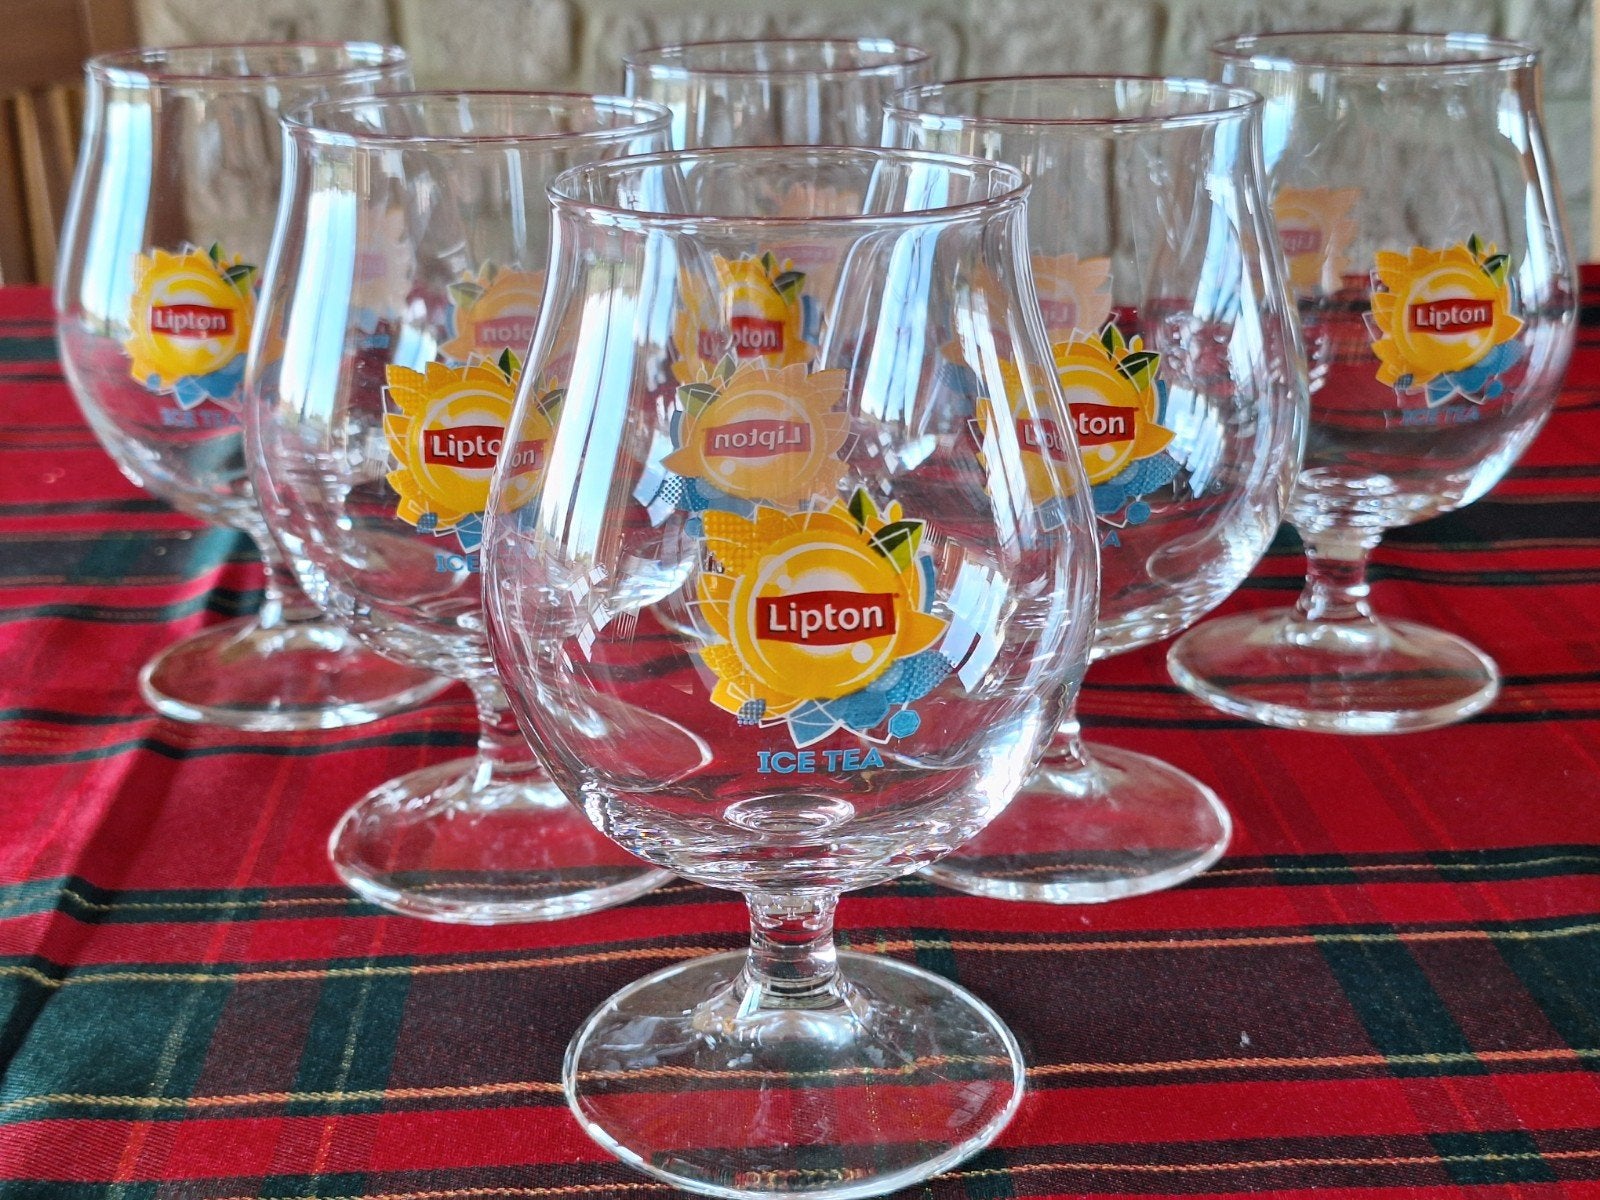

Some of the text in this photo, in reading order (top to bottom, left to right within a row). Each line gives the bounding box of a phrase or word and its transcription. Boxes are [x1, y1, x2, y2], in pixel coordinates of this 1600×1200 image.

[155, 308, 227, 334] Lipton
[1415, 305, 1487, 331] Lipton
[769, 602, 885, 639] Lipton
[757, 747, 885, 773] ICE TEA
